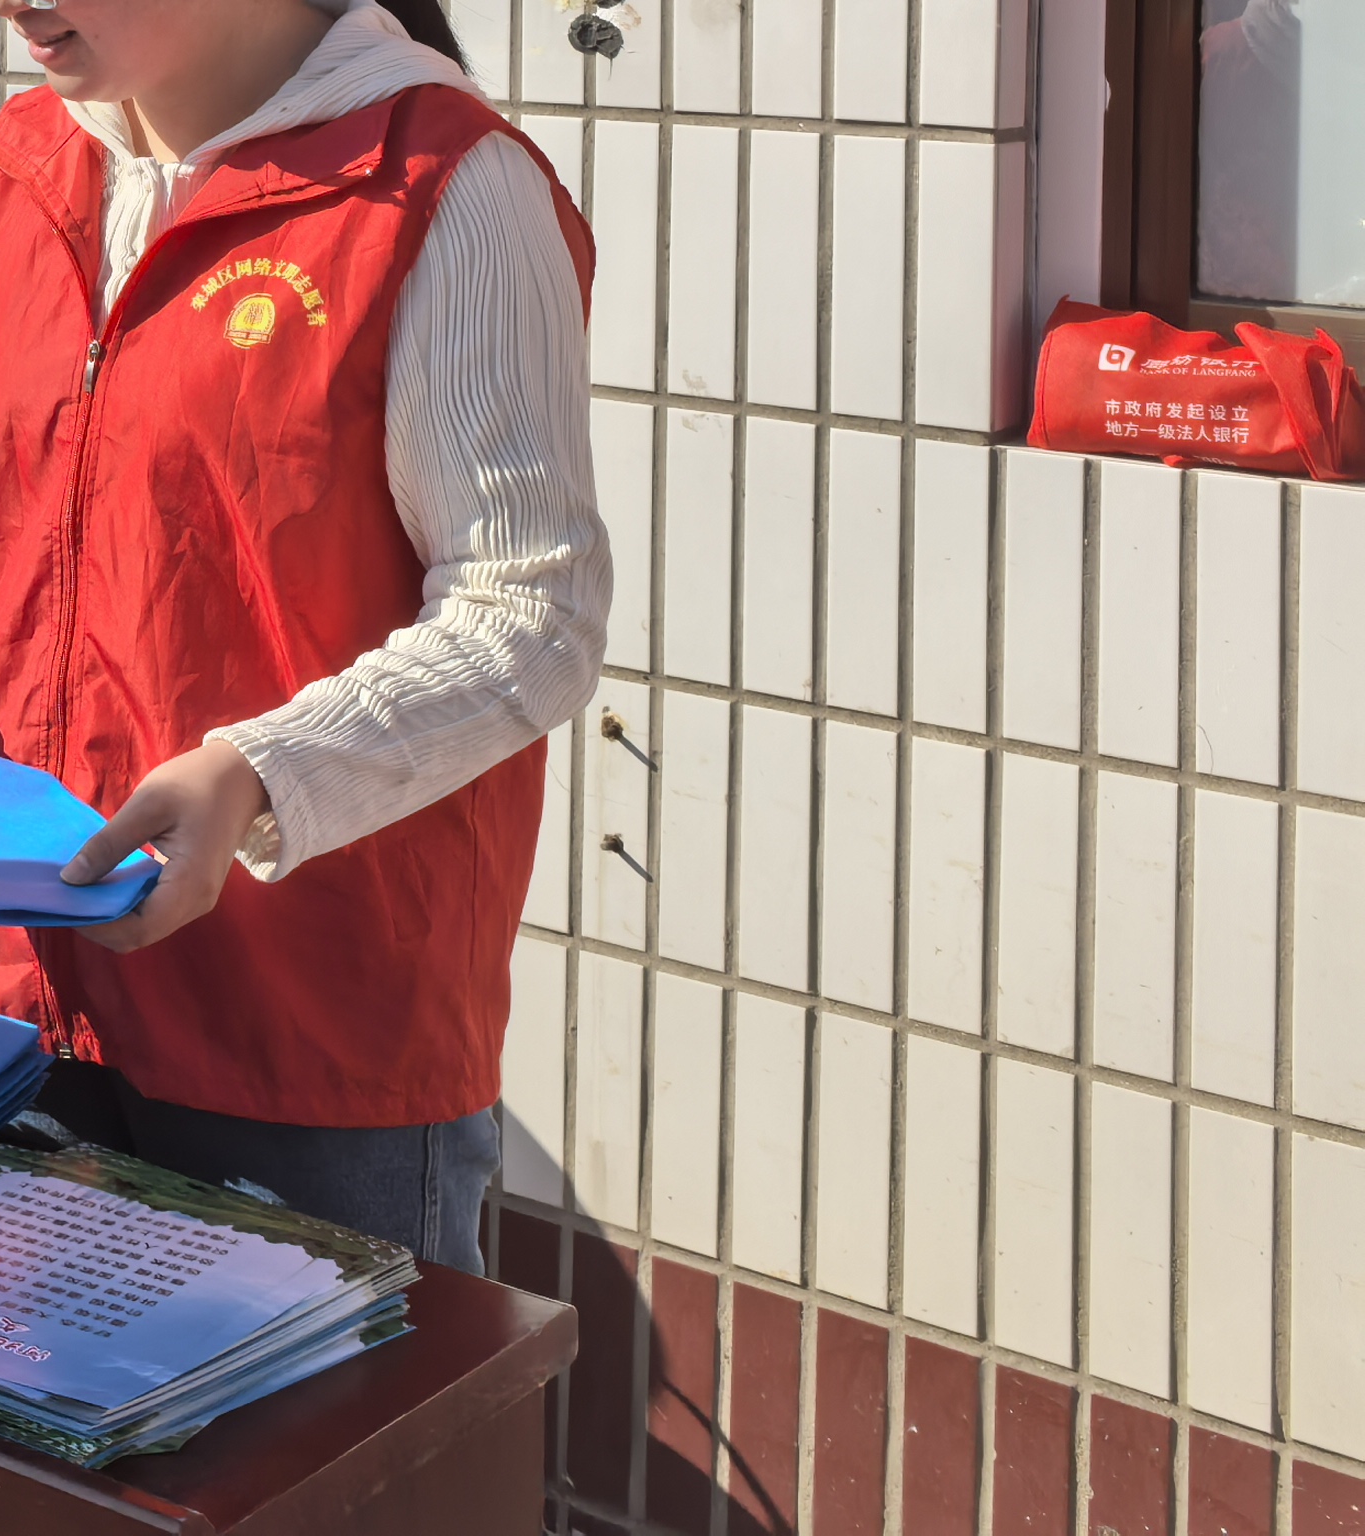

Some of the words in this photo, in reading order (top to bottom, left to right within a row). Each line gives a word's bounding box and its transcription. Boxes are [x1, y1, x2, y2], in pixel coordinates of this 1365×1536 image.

[190, 258, 328, 327] 栾城区网络文明志愿者
[1172, 366, 1189, 376] OF
[1192, 367, 1257, 378] LANGFANG
[1104, 398, 1250, 422] 市政府发起设立
[1104, 420, 1250, 445] 地方一级法人银行
